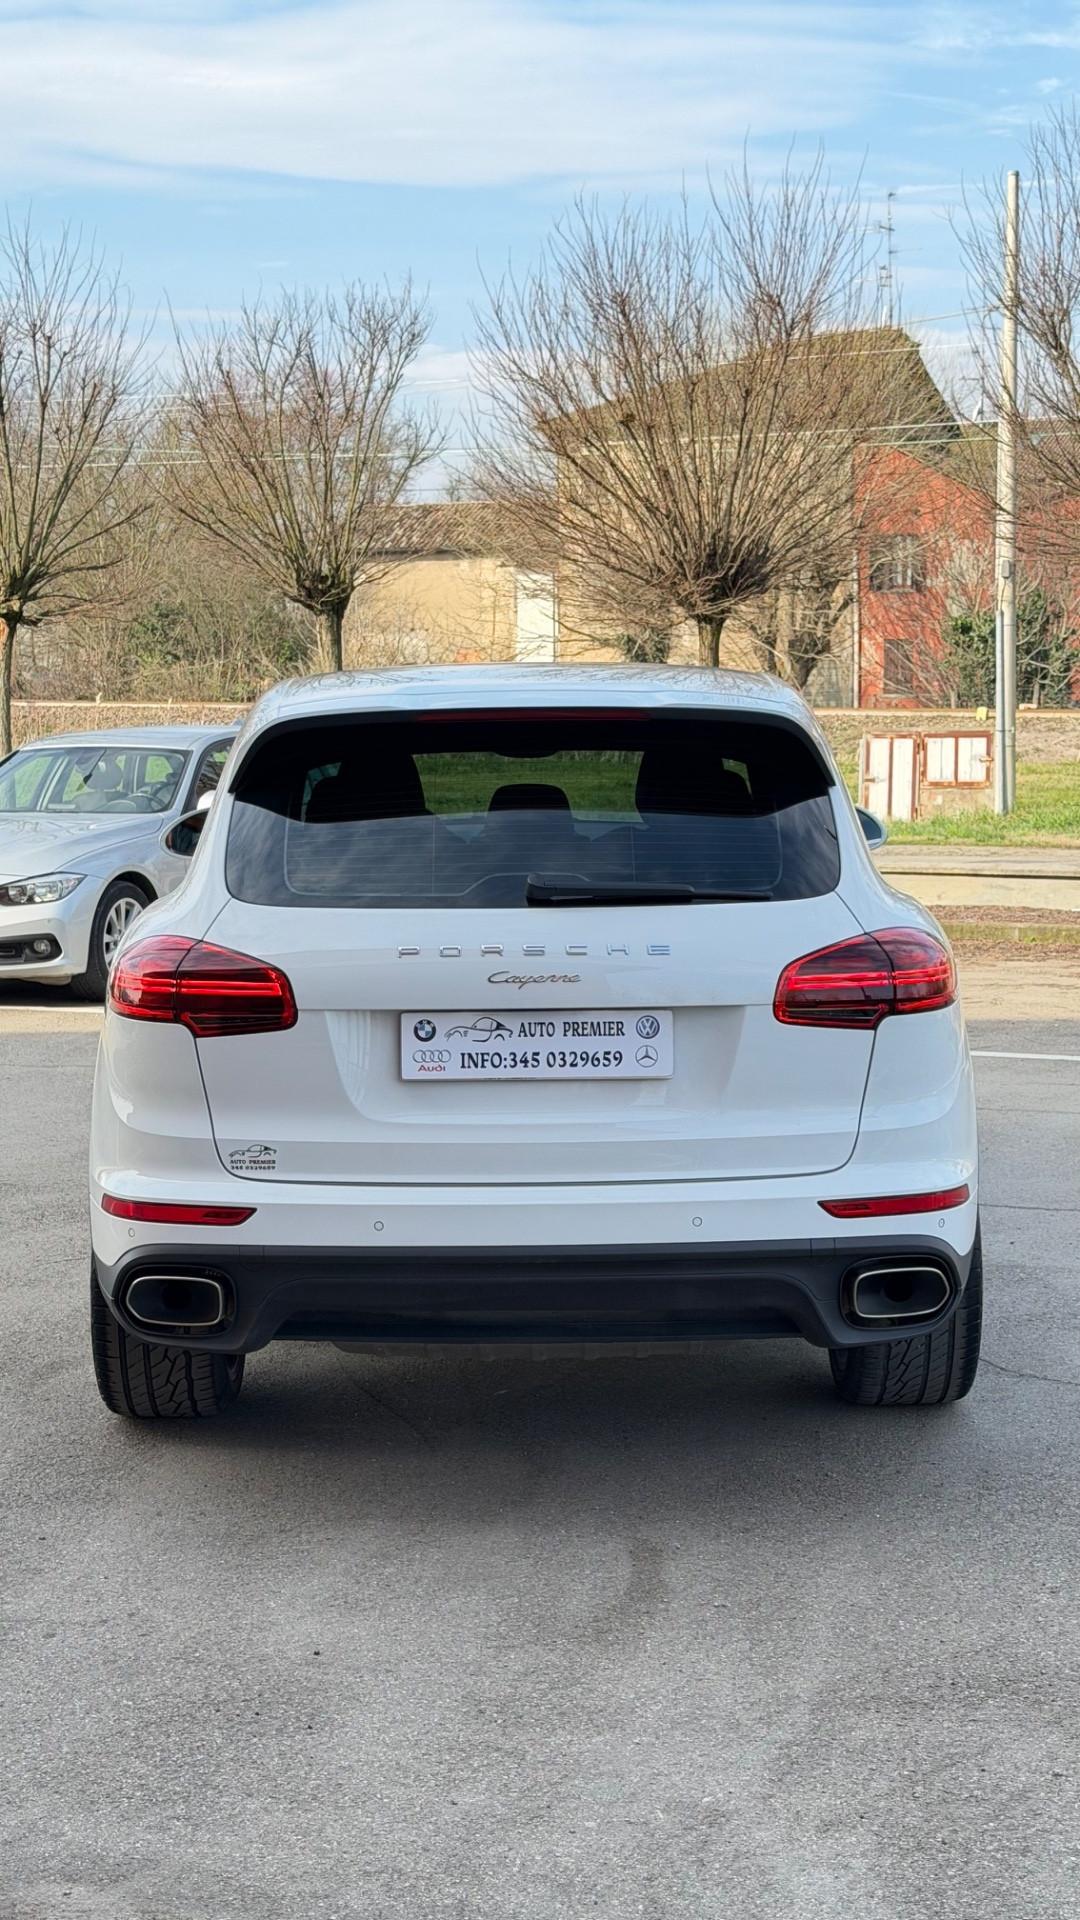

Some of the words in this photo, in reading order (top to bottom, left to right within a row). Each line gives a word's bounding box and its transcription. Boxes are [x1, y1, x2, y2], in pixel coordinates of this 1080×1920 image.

[398, 944, 671, 958] PORSCHE
[487, 970, 583, 990] Cayenne
[517, 1021, 556, 1038] AUTO
[562, 1020, 625, 1037] PREMIER
[417, 1064, 447, 1073] Audi
[460, 1051, 540, 1069] INFO:345
[546, 1050, 623, 1068] 0329659
